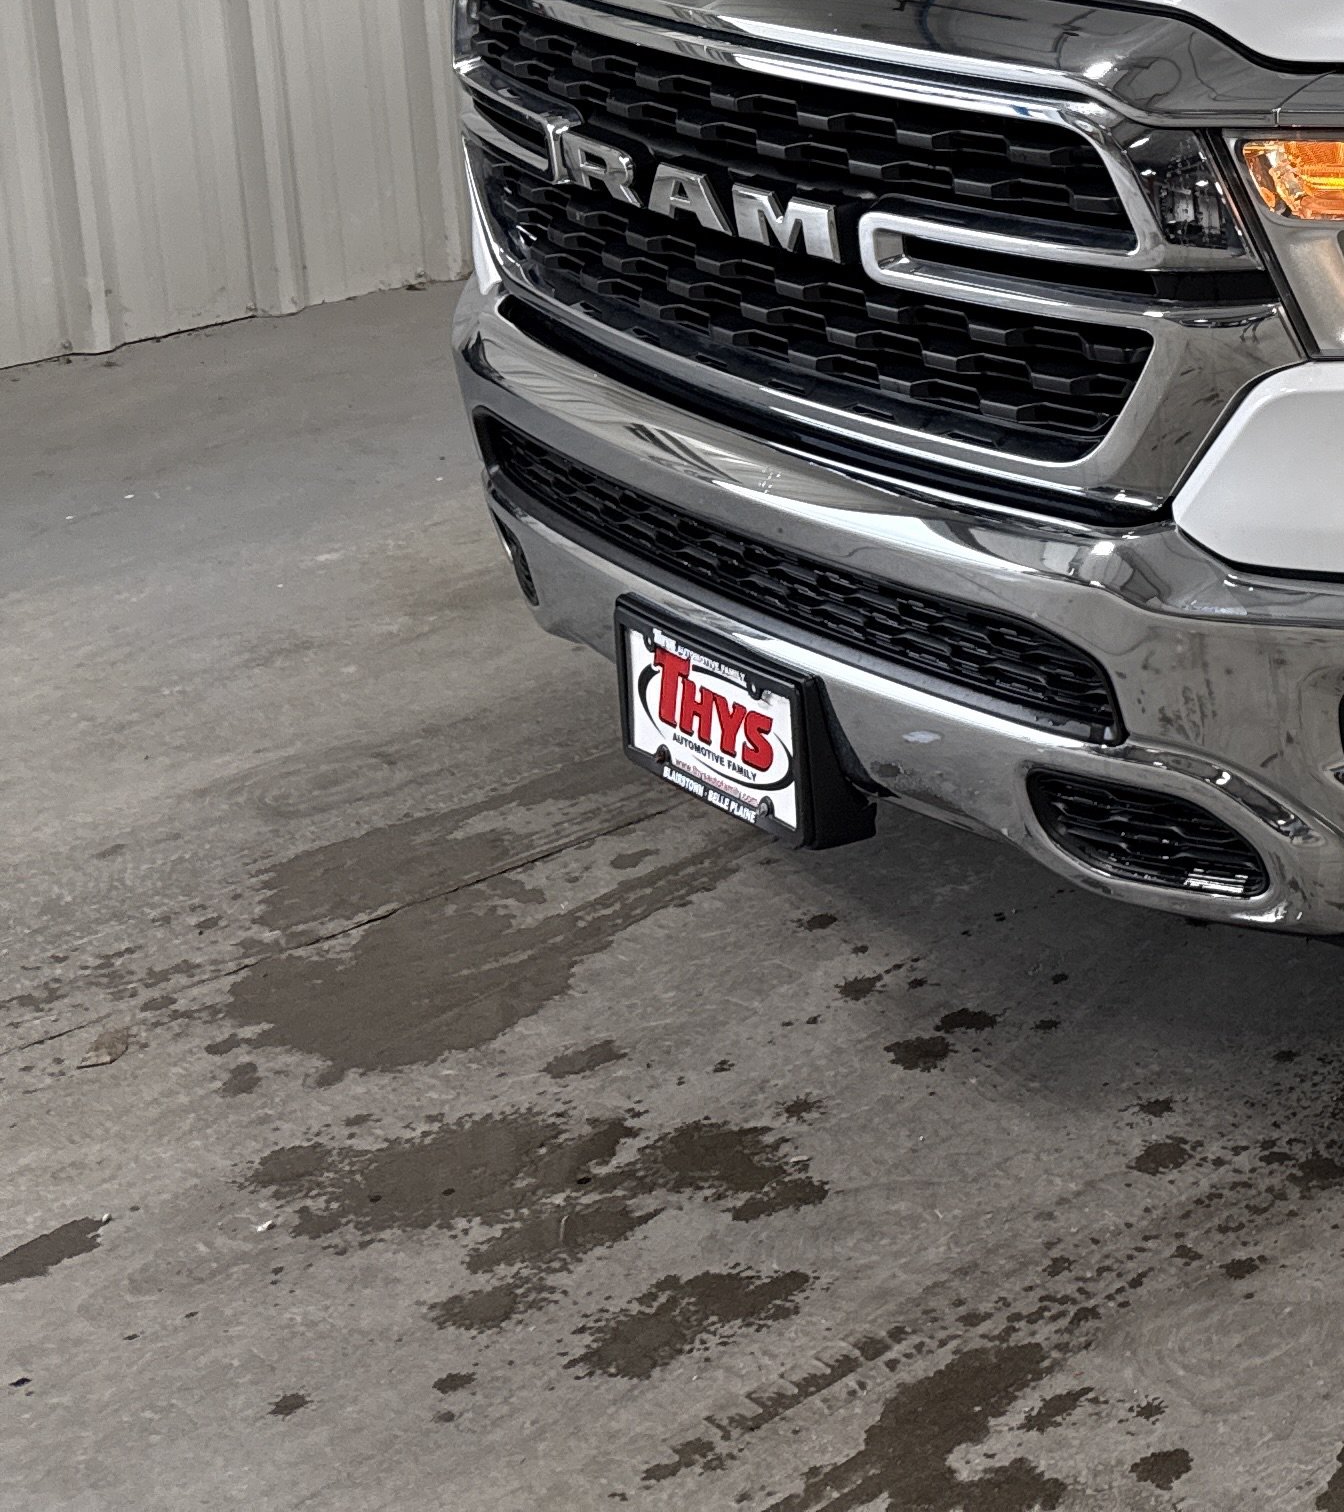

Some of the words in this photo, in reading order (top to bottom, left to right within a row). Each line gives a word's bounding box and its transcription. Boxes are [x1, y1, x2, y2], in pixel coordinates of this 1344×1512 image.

[561, 126, 842, 264] RAM
[654, 646, 774, 772] THYS
[672, 732, 725, 766] AUTOMOTIVE
[727, 759, 757, 782] FAMILY
[707, 789, 730, 810] BELLE
[729, 802, 757, 824] PLAINE
